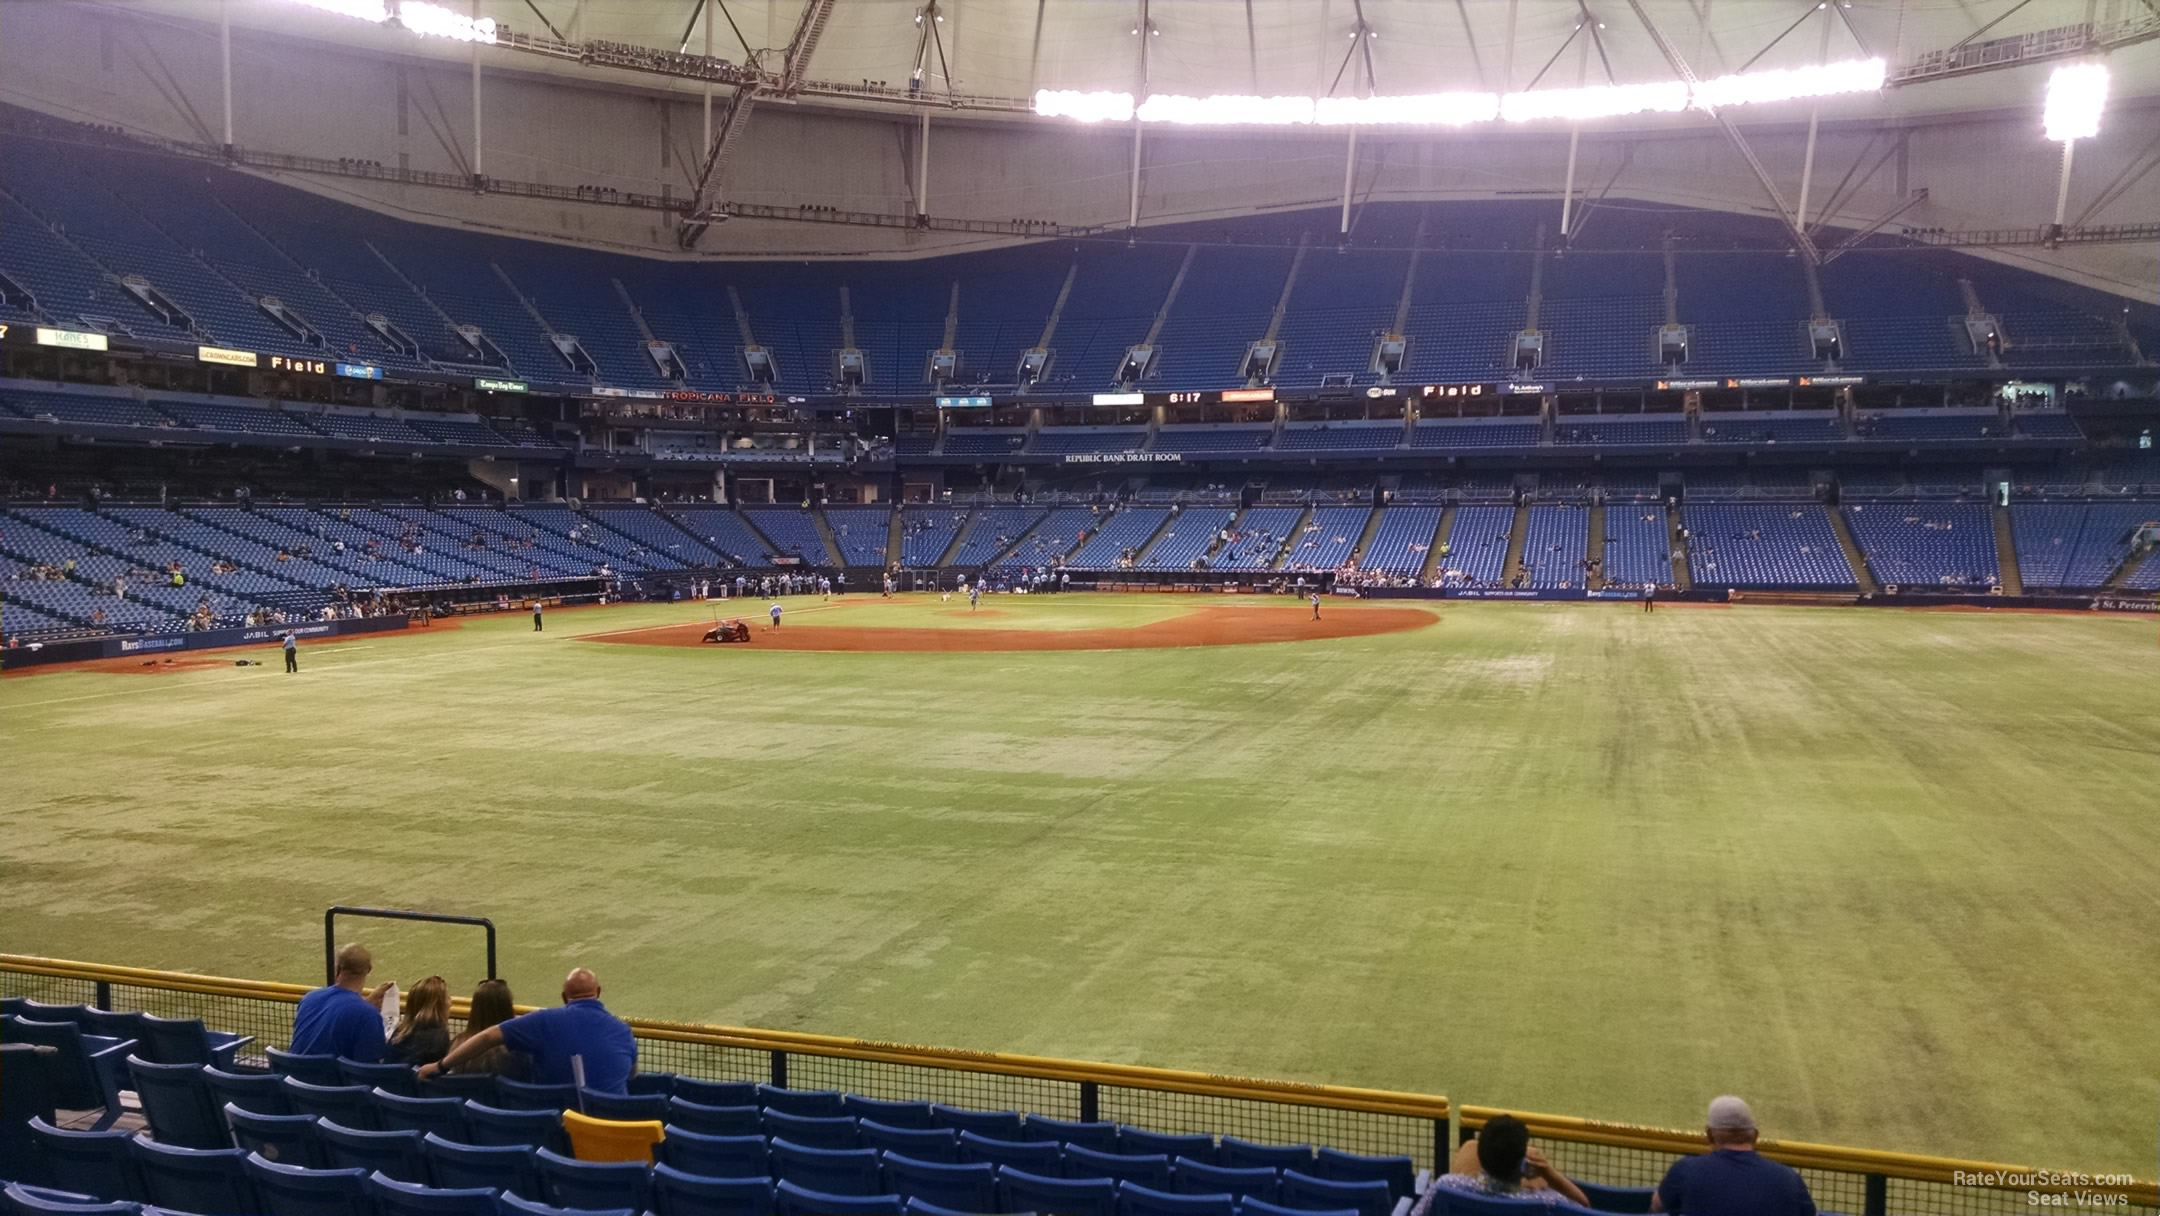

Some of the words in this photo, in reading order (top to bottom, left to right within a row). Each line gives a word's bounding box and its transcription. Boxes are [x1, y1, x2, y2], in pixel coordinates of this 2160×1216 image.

[271, 356, 325, 374] Field
[480, 380, 498, 389] Tampa
[498, 381, 508, 390] Bay
[508, 382, 524, 390] Times
[1424, 385, 1482, 397] Field
[664, 391, 731, 402] TROPICANA
[739, 394, 775, 403] FIELD
[1169, 392, 1200, 403] 6:17
[1065, 454, 1102, 463] REPUBLIC
[1103, 454, 1126, 462] BANK
[1127, 453, 1154, 462] DRAFT
[1155, 453, 1181, 461] ROOM
[2102, 600, 2116, 609] St.
[243, 631, 270, 639] JABIL
[303, 626, 329, 634] COMMUNITY
